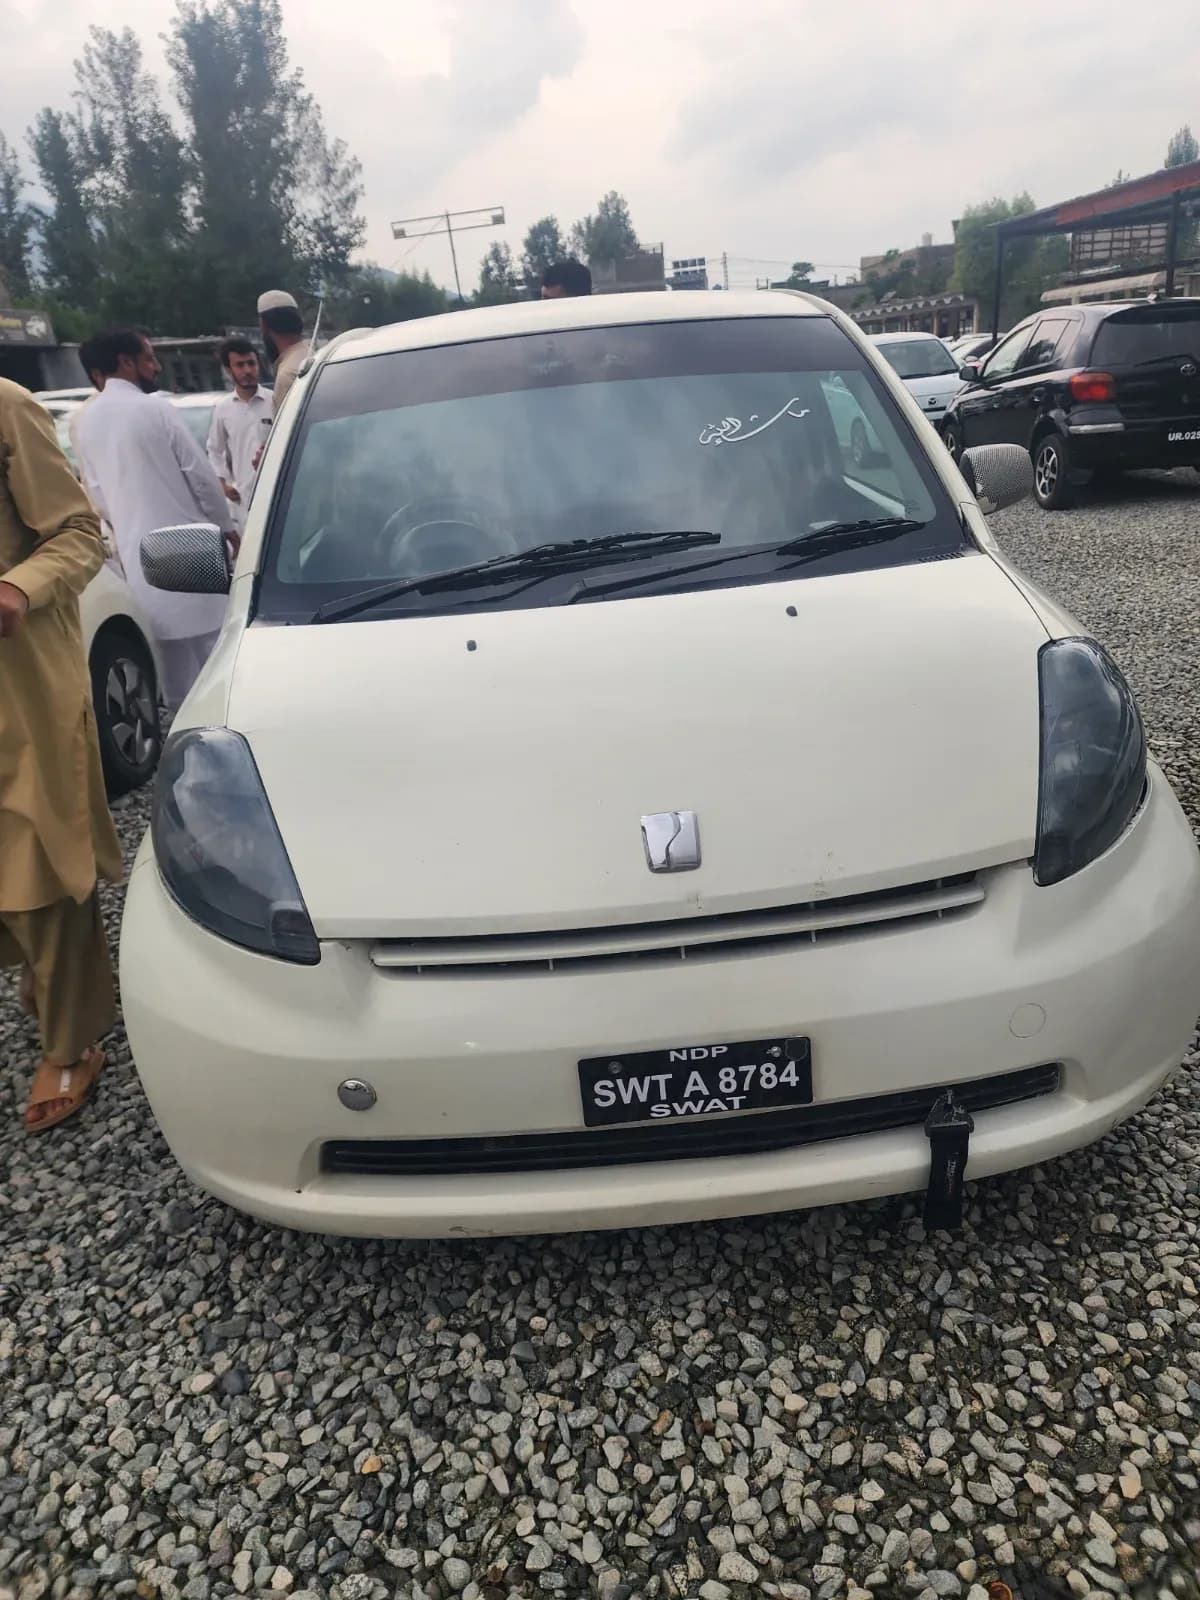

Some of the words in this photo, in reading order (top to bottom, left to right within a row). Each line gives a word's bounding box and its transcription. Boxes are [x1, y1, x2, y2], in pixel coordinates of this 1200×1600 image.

[669, 1045, 728, 1062] NDP
[593, 1073, 673, 1108] SWT
[683, 1070, 710, 1098] A
[718, 1060, 800, 1094] 8784
[650, 1095, 747, 1118] SWAT
